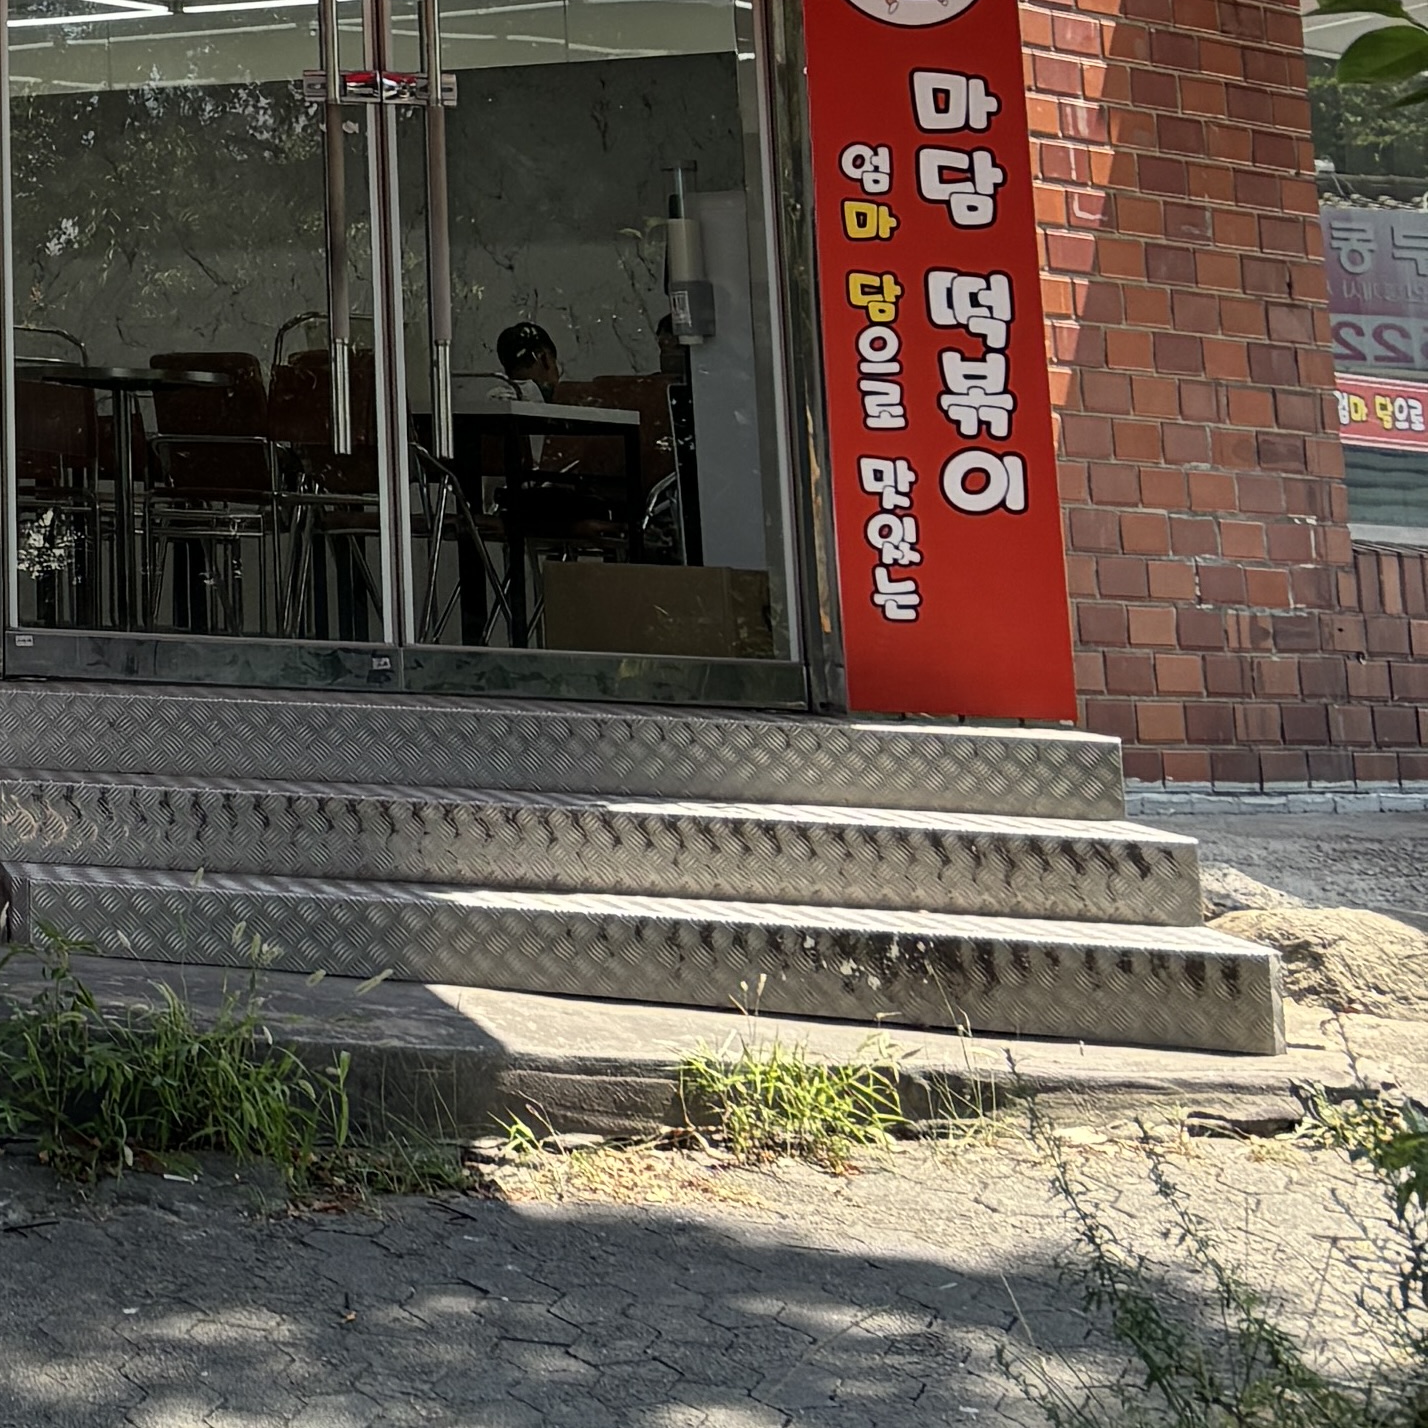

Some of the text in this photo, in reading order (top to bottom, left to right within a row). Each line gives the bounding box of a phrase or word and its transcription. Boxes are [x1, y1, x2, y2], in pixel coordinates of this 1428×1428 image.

[839, 142, 924, 622] 엄마 담으로 맛있는
[909, 67, 1028, 516] 마담 떡볶이
[1374, 394, 1426, 431] 담으로
